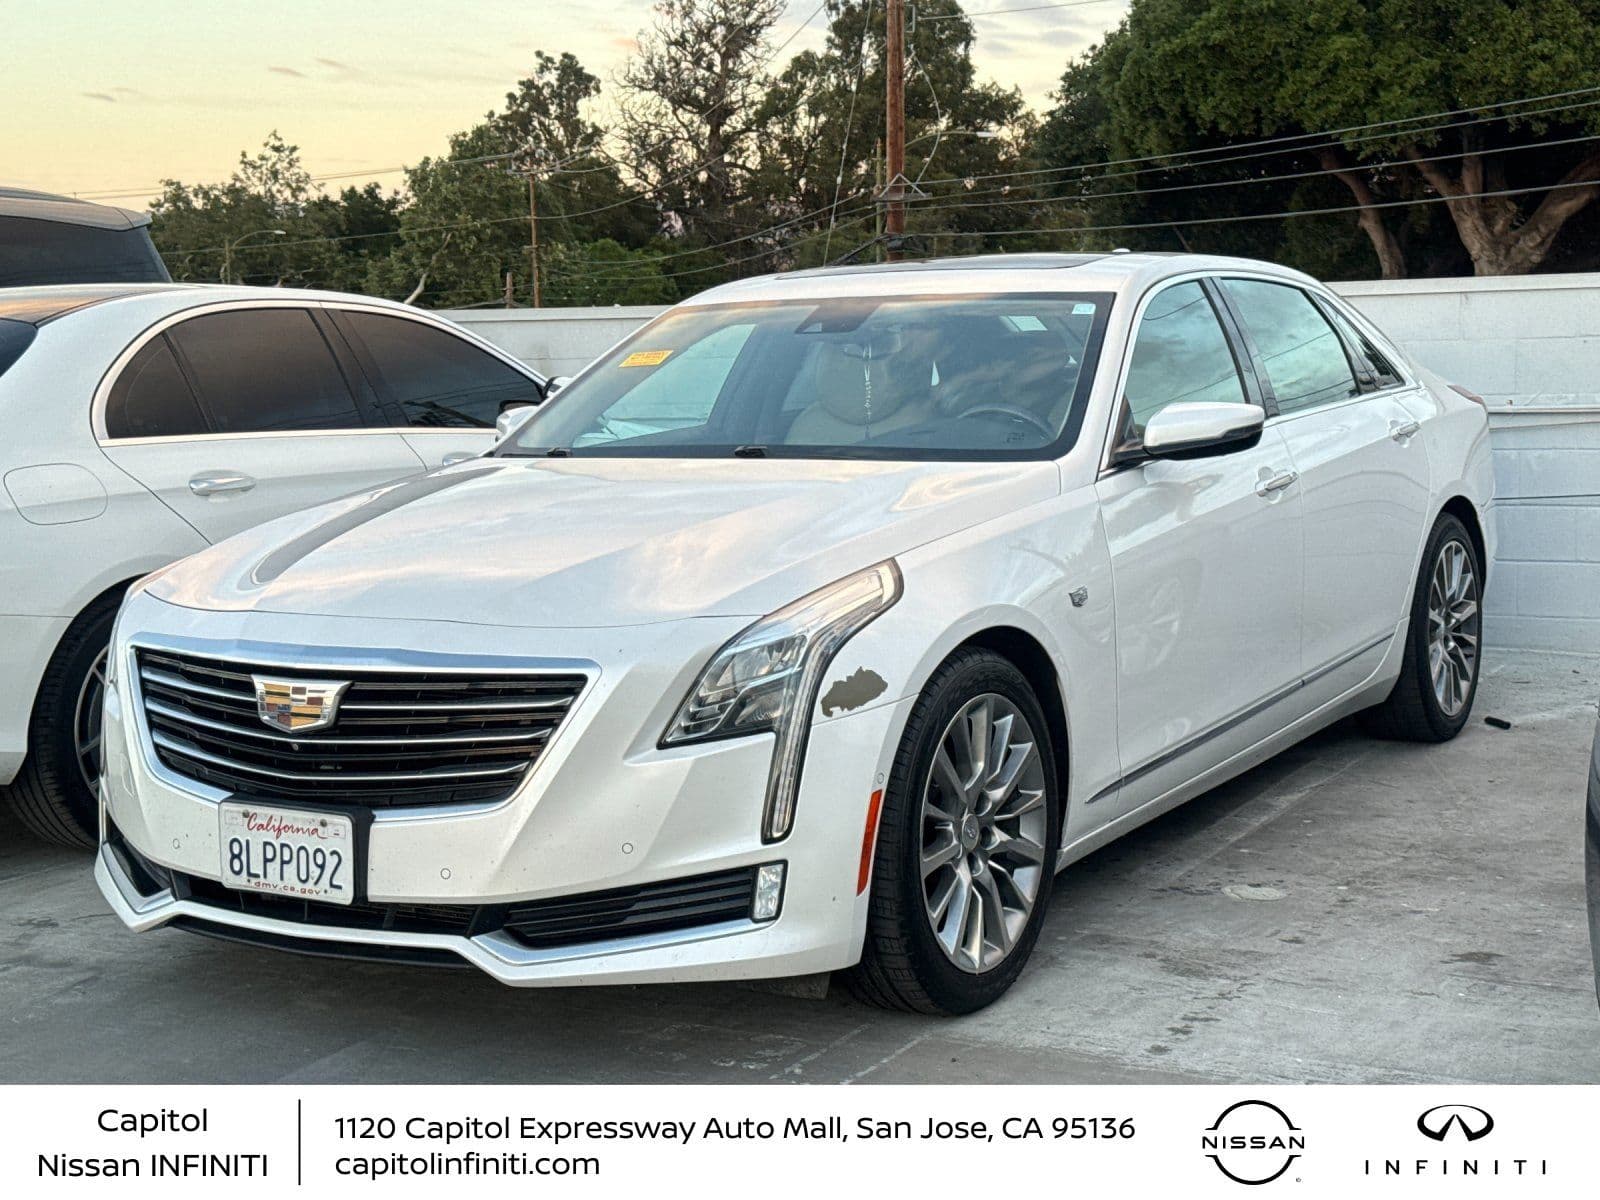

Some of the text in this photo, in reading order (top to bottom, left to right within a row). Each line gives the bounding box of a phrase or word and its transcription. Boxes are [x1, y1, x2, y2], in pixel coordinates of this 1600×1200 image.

[246, 812, 328, 840] California
[229, 837, 343, 891] 8LPP092
[254, 880, 321, 896] dmv.ca.gov
